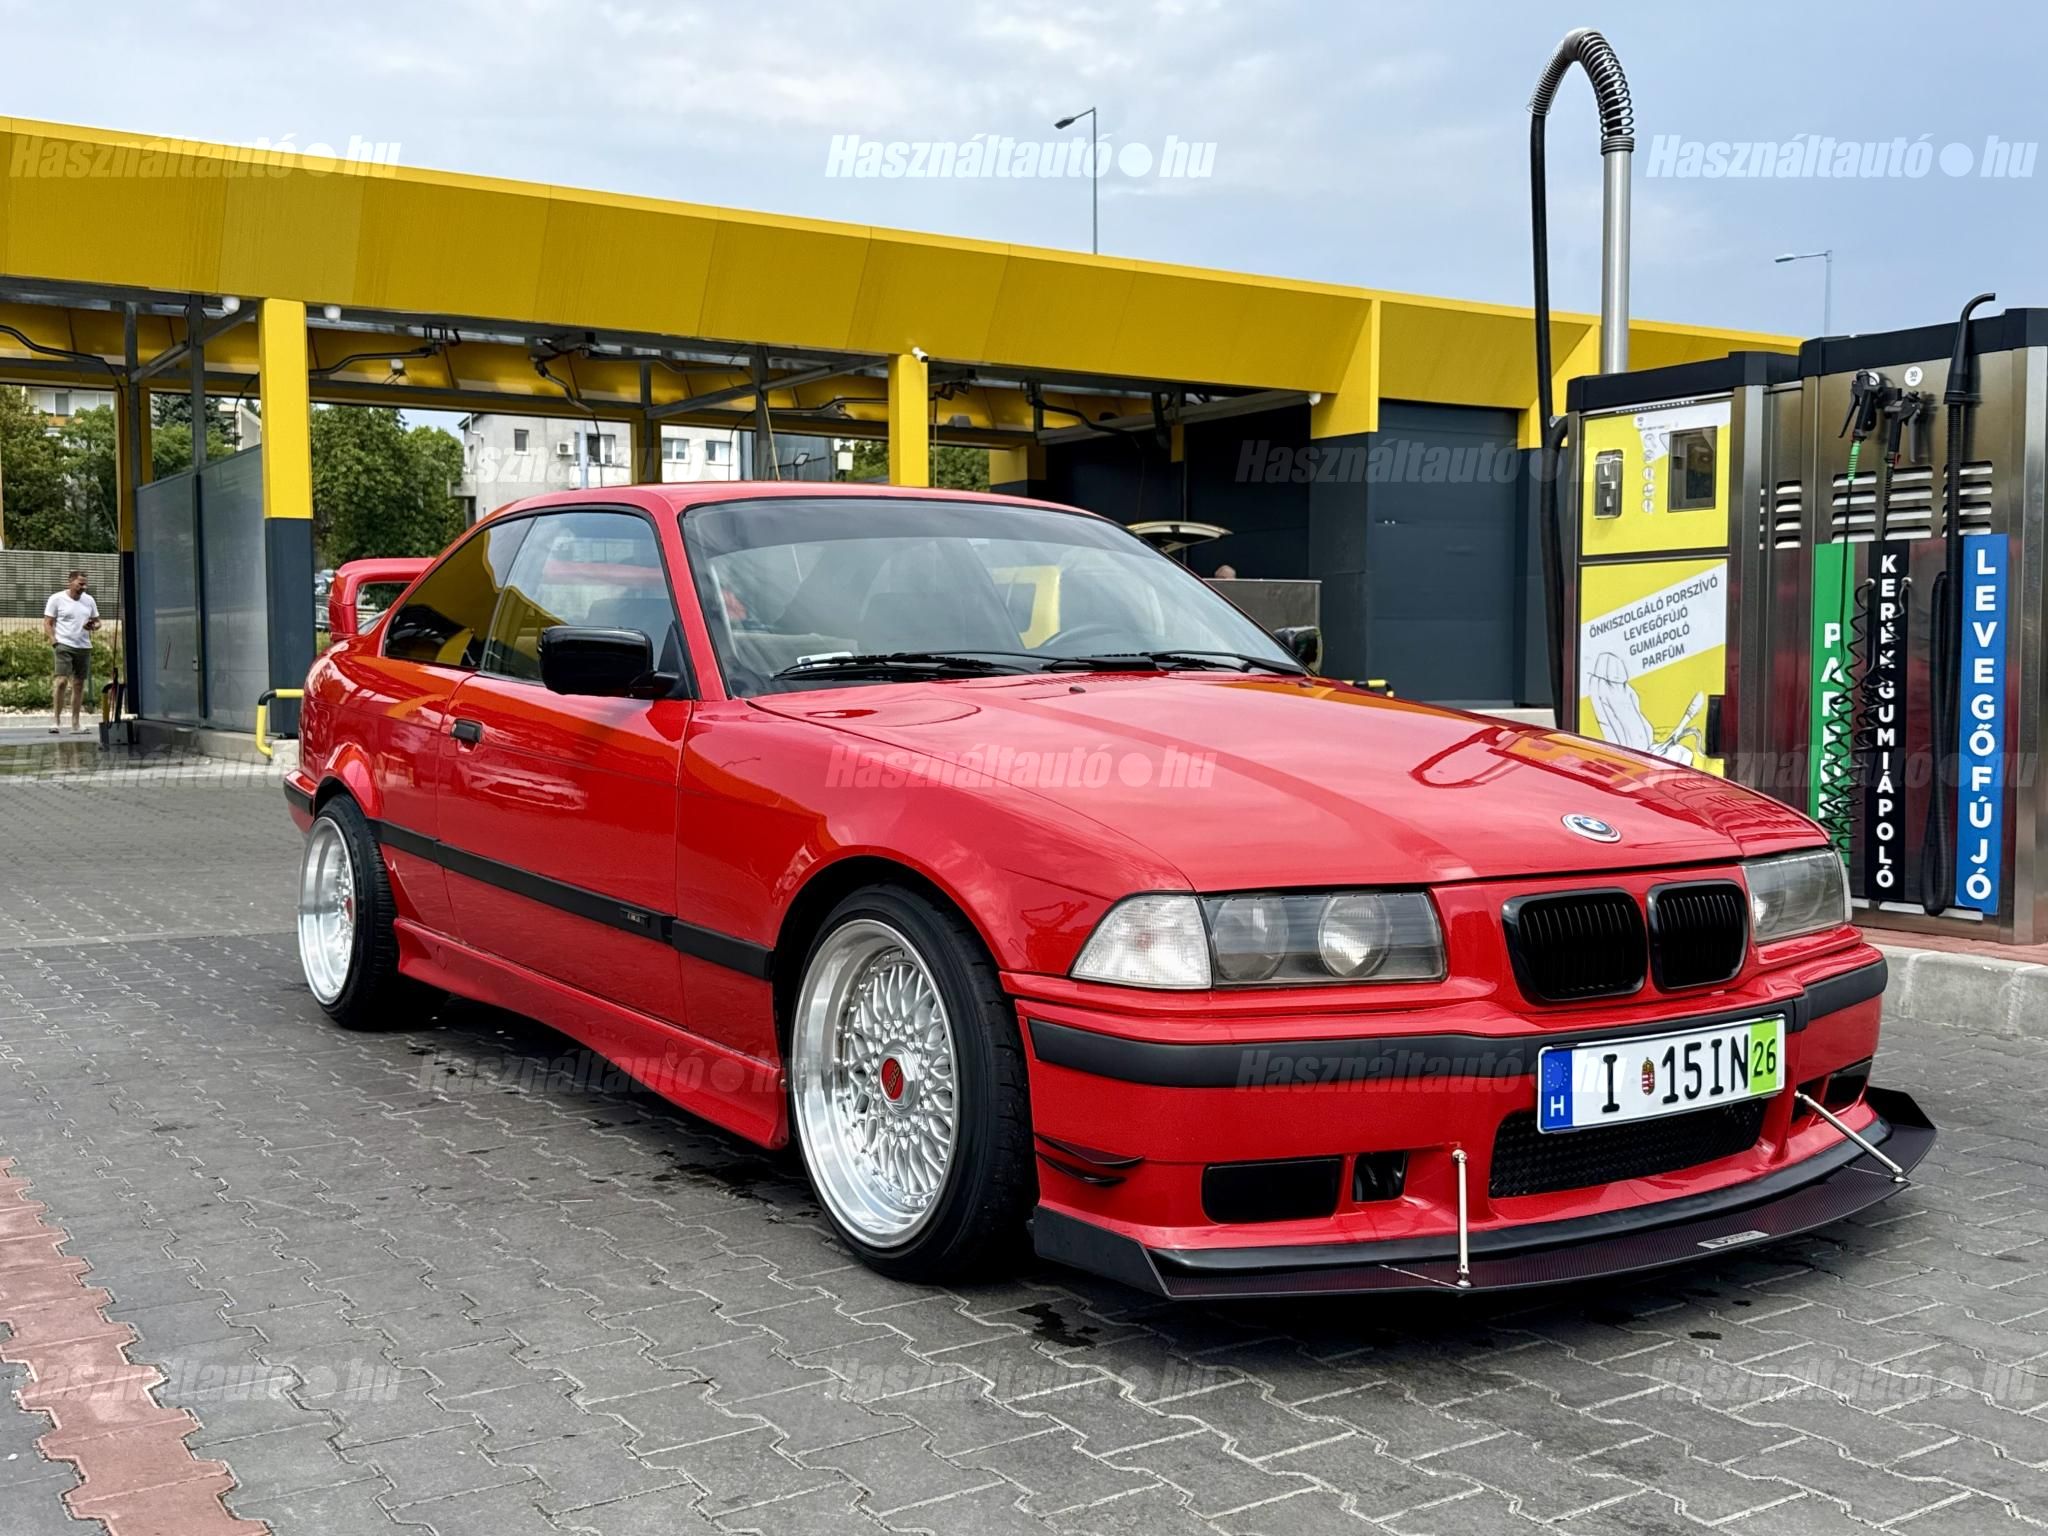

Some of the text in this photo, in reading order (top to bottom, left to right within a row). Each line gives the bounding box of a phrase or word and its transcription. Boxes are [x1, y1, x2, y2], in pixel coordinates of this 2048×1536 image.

[1589, 574, 1718, 638] ÖNKISZOLGÁLÓ PORSZÍVÓ
[1623, 606, 1689, 642] LEVEGŐFÚJÓ
[1629, 622, 1691, 657] GUMIÁPOLÓ
[1642, 643, 1685, 669] PARFÜM
[1966, 548, 1997, 900] LEVEGŐFÚJÓ
[1602, 1034, 1777, 1113] I 15IN 26
[1550, 1094, 1565, 1117] H
